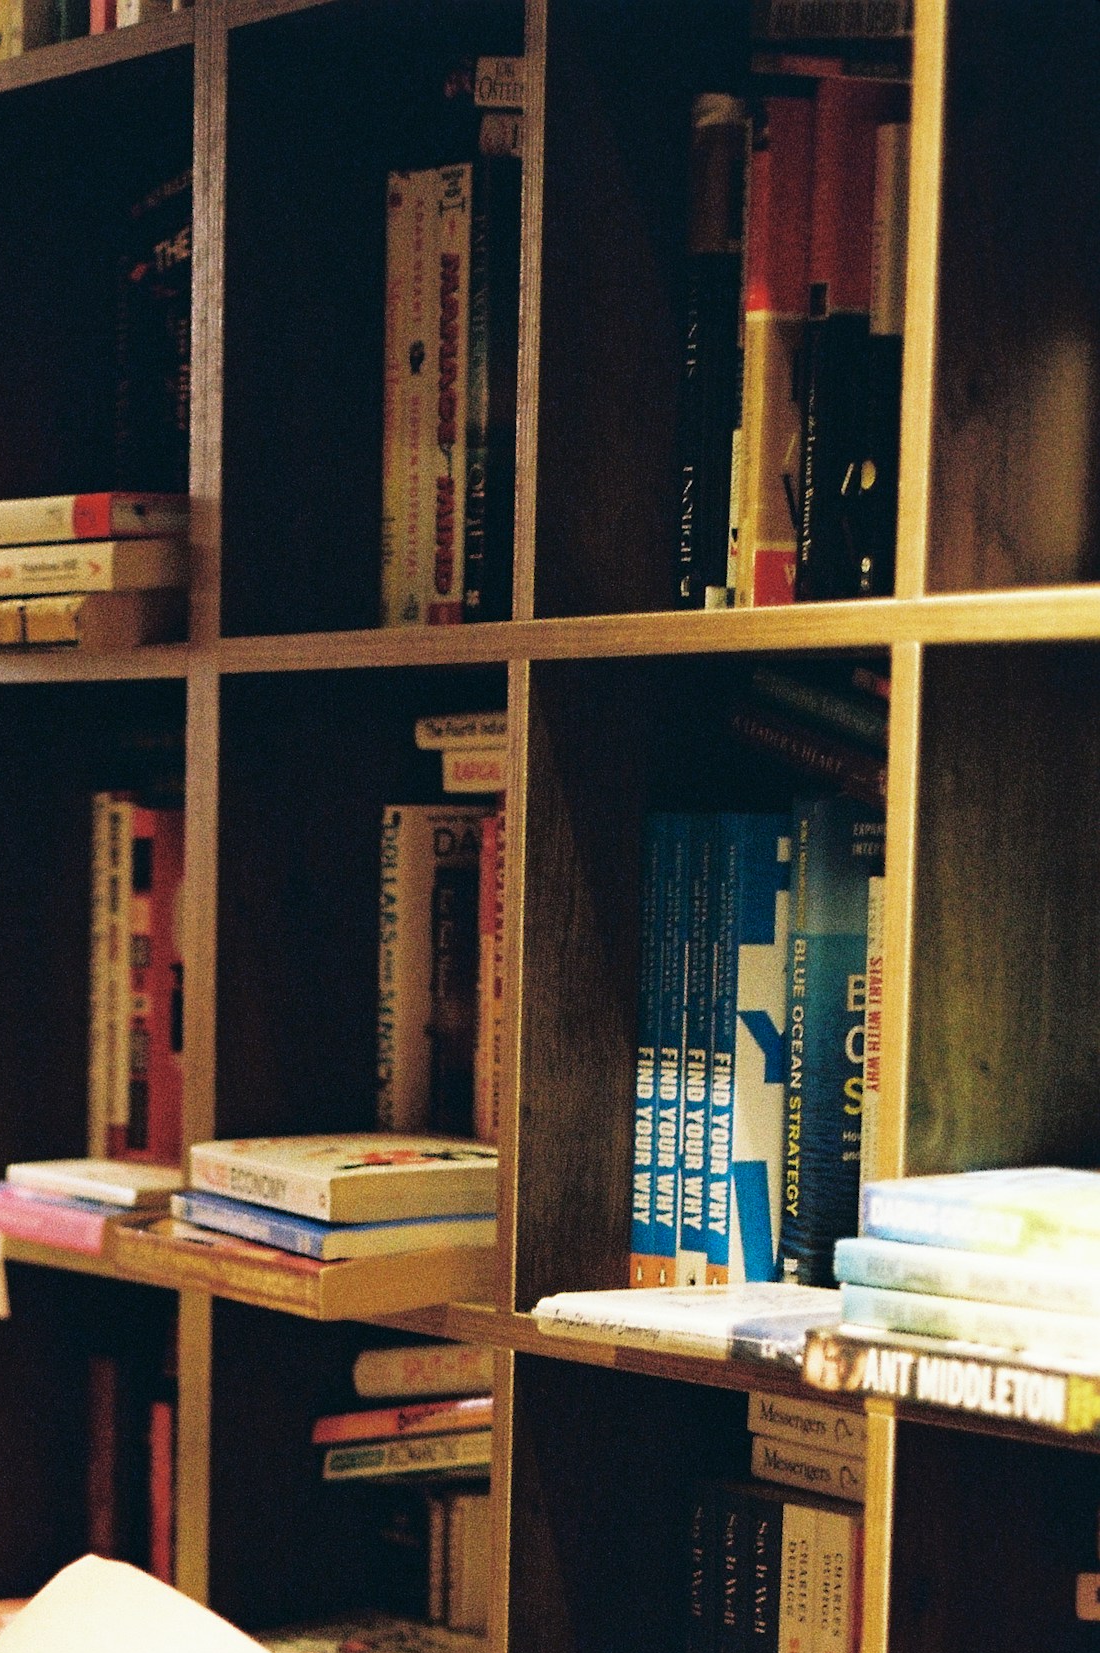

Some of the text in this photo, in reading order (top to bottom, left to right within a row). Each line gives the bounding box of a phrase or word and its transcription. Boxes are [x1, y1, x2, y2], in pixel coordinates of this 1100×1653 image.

[792, 938, 807, 1000] BLUE
[868, 956, 884, 1005] START
[789, 1004, 805, 1089] OCEAN
[866, 1010, 882, 1052] WITH
[637, 1046, 656, 1100] FIND
[864, 1057, 880, 1093] WHY
[634, 1104, 654, 1166] YOUR
[655, 1046, 679, 1228] FIND YOUR WHY
[682, 1047, 706, 1231] FIND YOUR WHY
[707, 1052, 733, 1236] FIND YOUR WHY
[785, 1095, 802, 1218] STRATEGY
[632, 1171, 652, 1226] WHY
[760, 1399, 827, 1435] Messengers
[862, 1346, 1067, 1426] ANT MIDDLETON
[763, 1446, 832, 1482] Messengers
[798, 1539, 810, 1623] CHARLES
[832, 1552, 844, 1638] CHARLES
